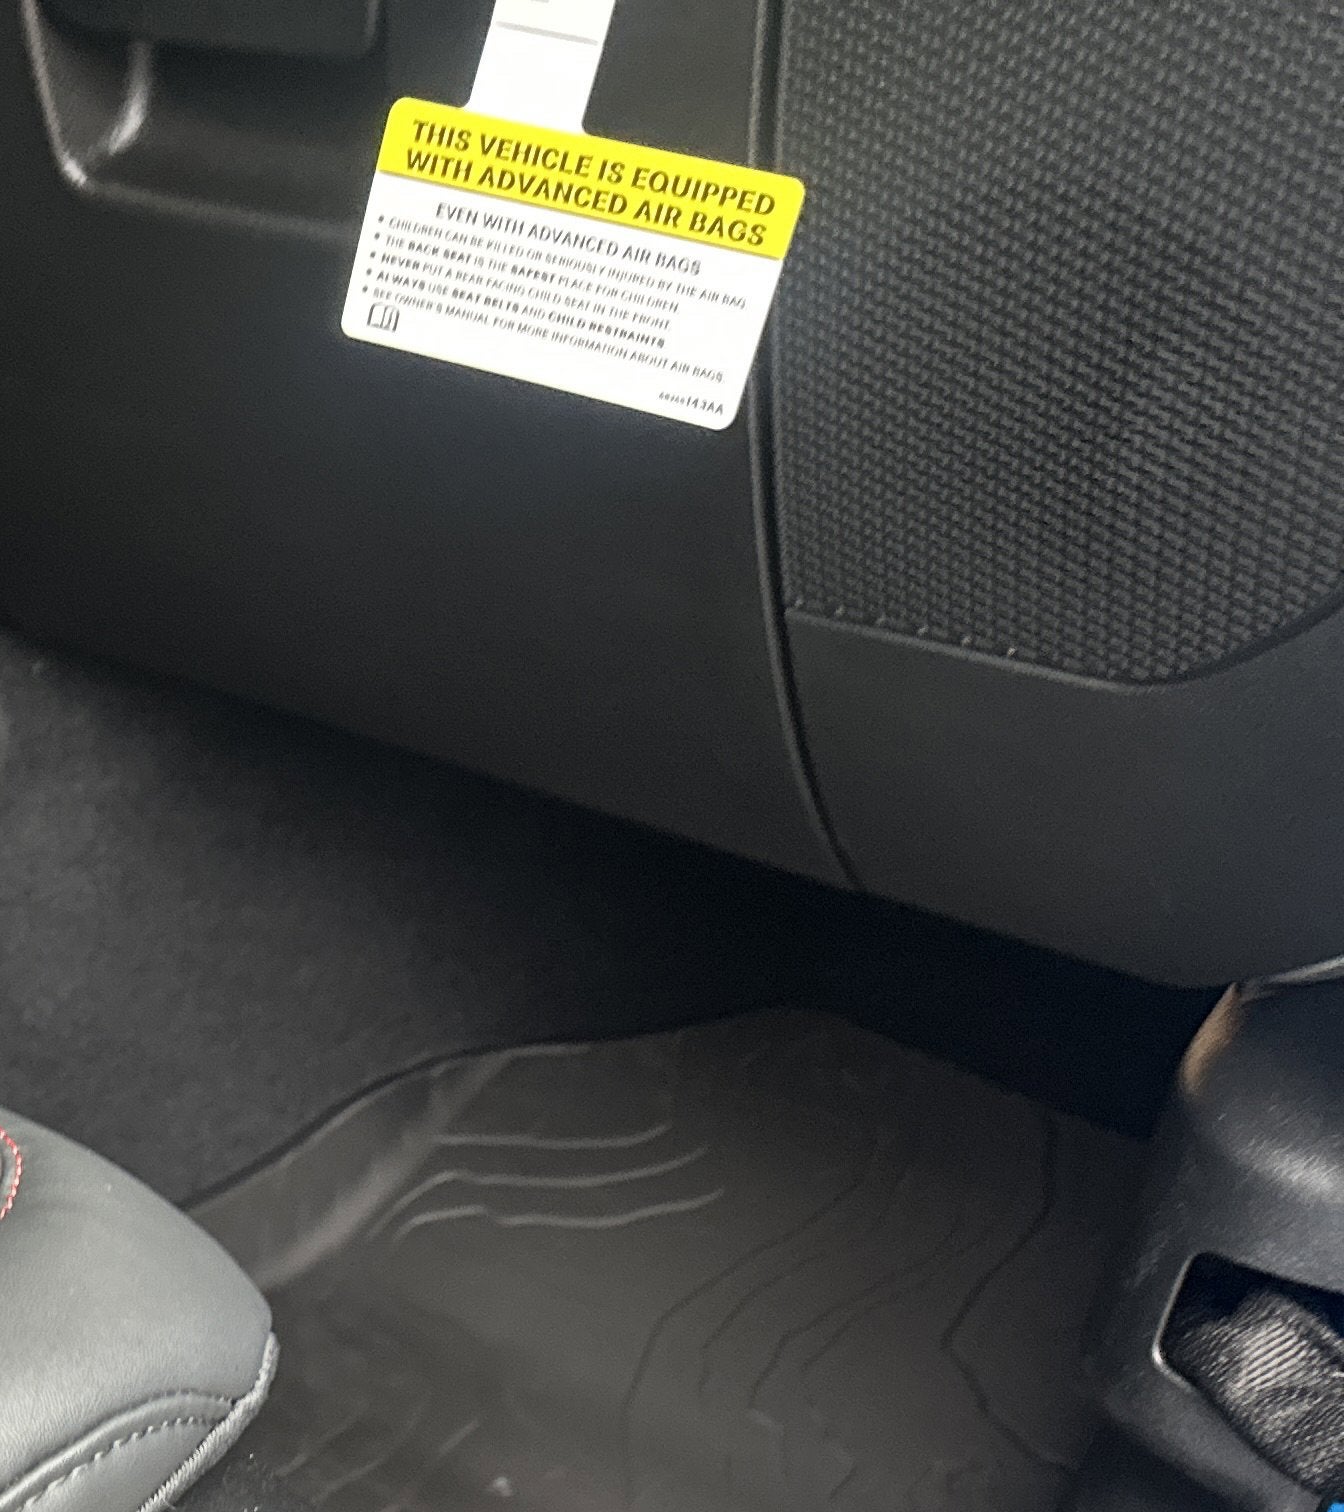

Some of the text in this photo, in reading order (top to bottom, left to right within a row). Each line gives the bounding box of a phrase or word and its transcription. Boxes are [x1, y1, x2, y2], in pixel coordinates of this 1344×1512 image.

[406, 147, 767, 246] WITH ADVANCED AIR BAGS
[413, 119, 775, 216] THIS VEHICLE IS EQUIPPED
[435, 202, 701, 276] EVEN WITH ADVANCED AIR BAGS
